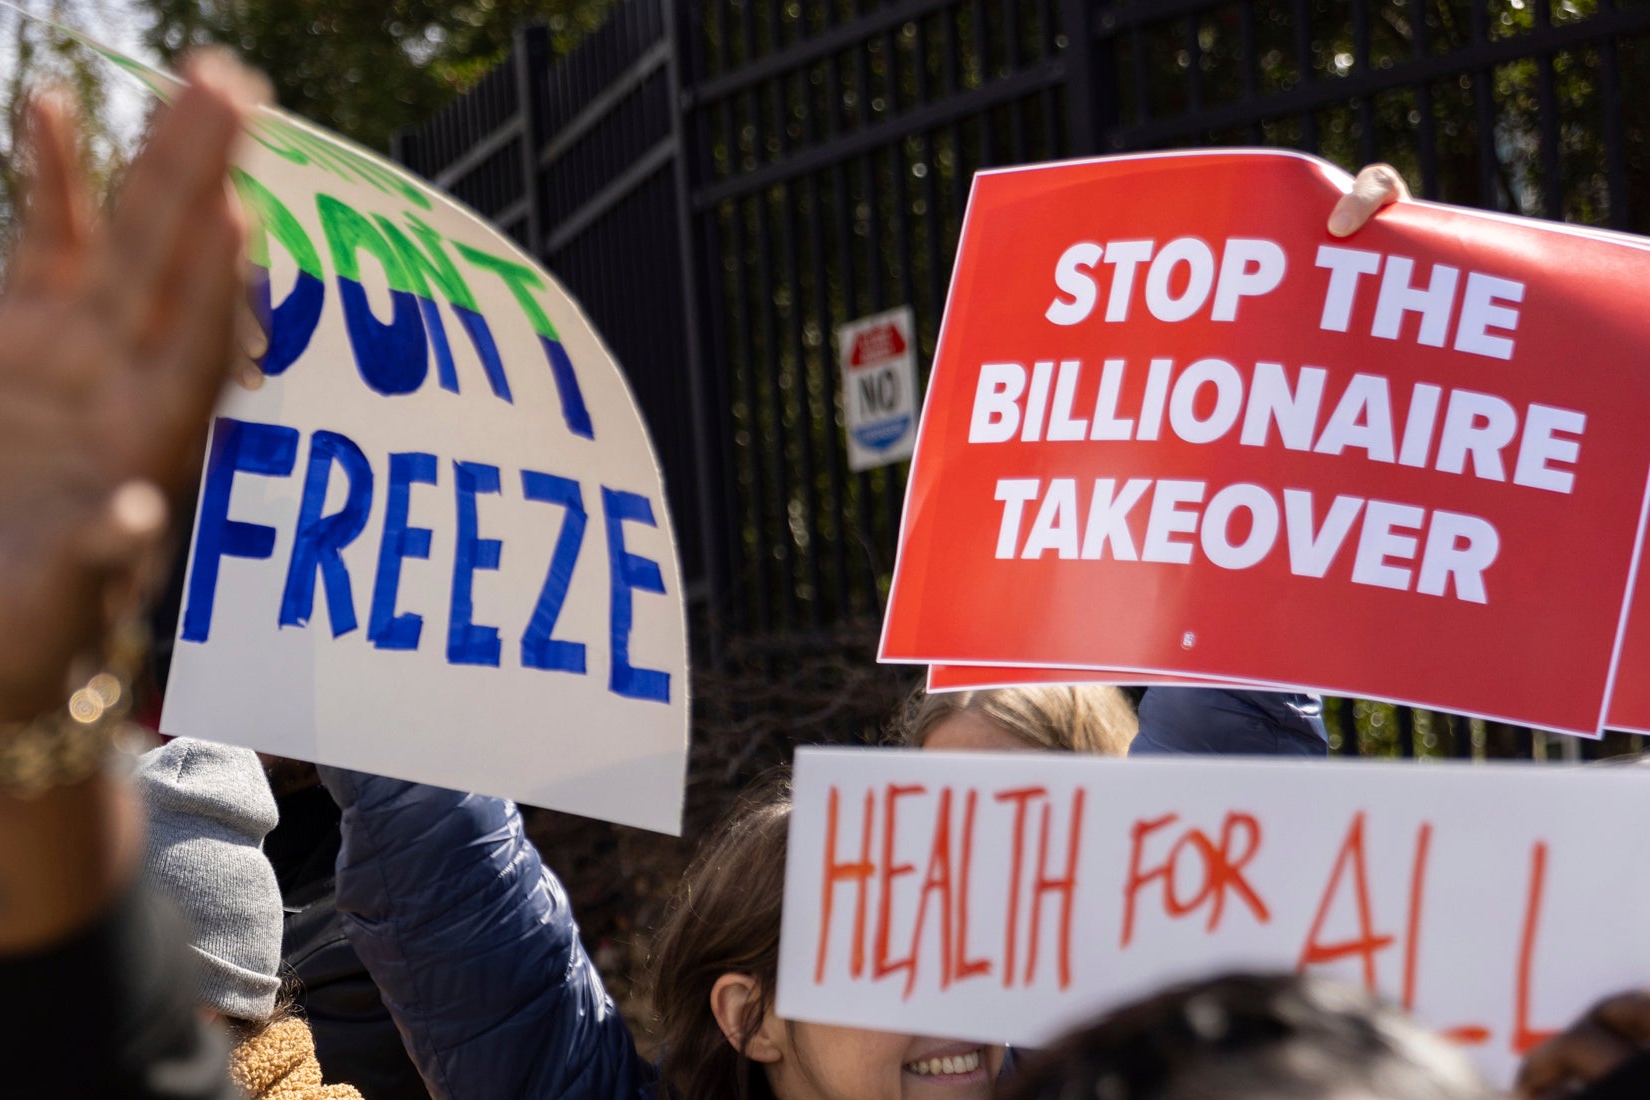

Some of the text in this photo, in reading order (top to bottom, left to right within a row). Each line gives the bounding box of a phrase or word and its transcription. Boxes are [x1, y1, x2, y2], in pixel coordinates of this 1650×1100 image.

[1044, 237, 1525, 361] STOP THE
[859, 369, 896, 419] NO
[968, 358, 1588, 495] BILLIONAIRE
[179, 417, 672, 704] FREEZE
[993, 478, 1500, 604] TAKEOVER
[815, 785, 1086, 999] HEALTH
[1121, 811, 1271, 950] FOR
